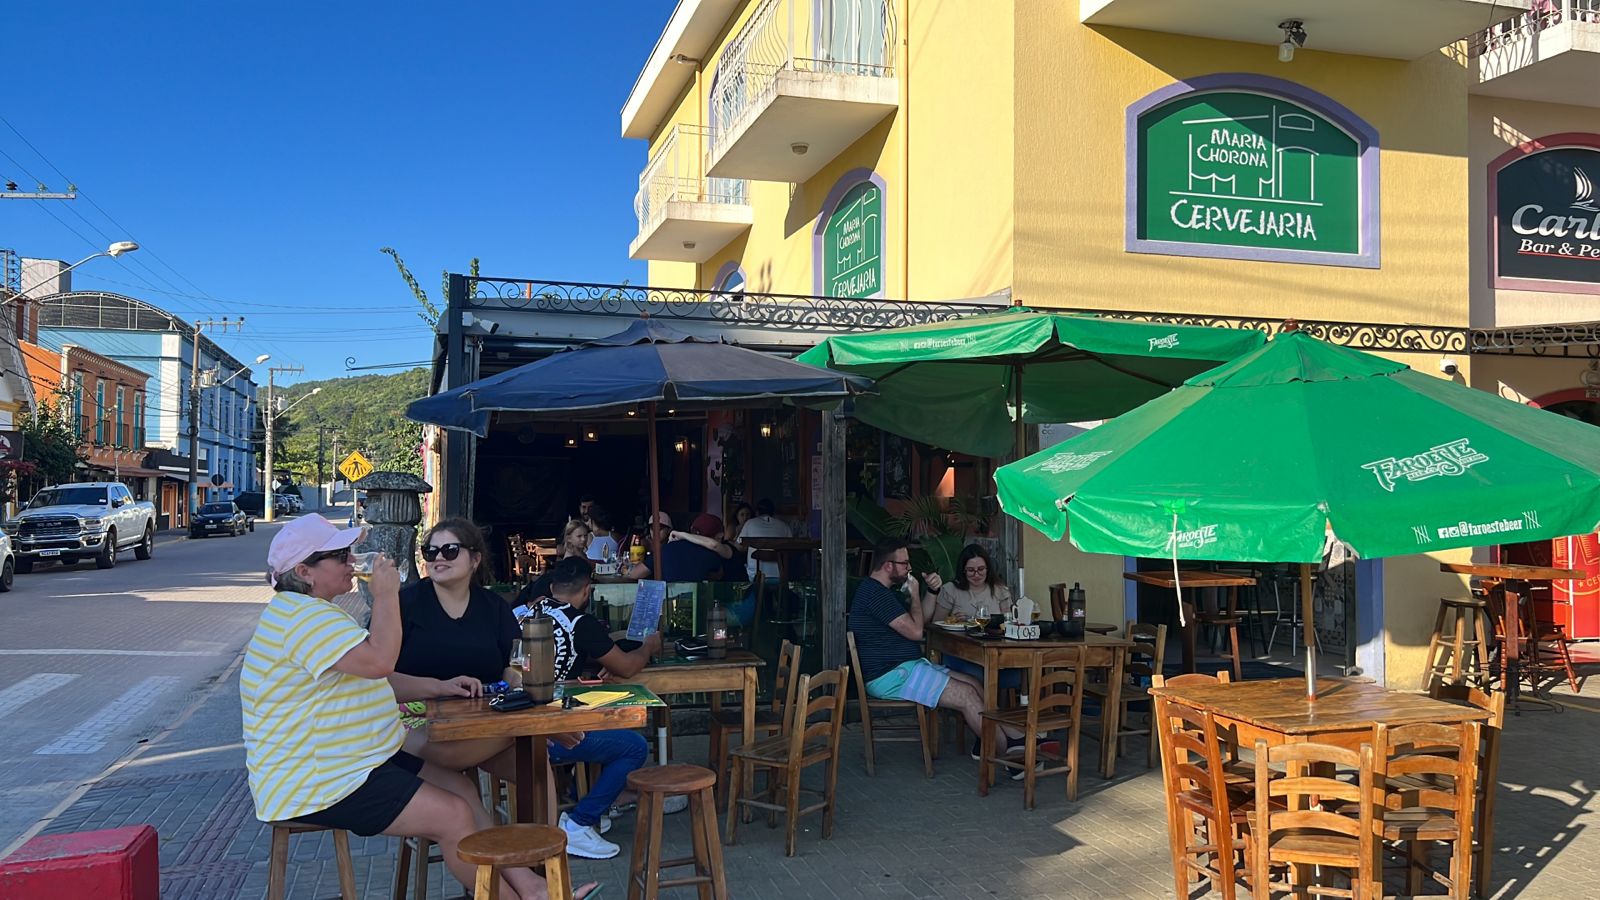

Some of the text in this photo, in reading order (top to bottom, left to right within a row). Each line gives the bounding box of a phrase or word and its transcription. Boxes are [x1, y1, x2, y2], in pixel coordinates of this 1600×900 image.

[1211, 128, 1267, 151] MARIA
[1197, 143, 1268, 169] CHORONA
[843, 216, 861, 236] MARIA
[1170, 199, 1317, 241] CERVEJARIA
[839, 229, 861, 250] CHORONA
[1519, 238, 1600, 258] Bar & Pe
[832, 267, 877, 298] CERVEJARIA
[1361, 437, 1478, 492] FAROESTE
[1458, 518, 1523, 537] @faroestebeer
